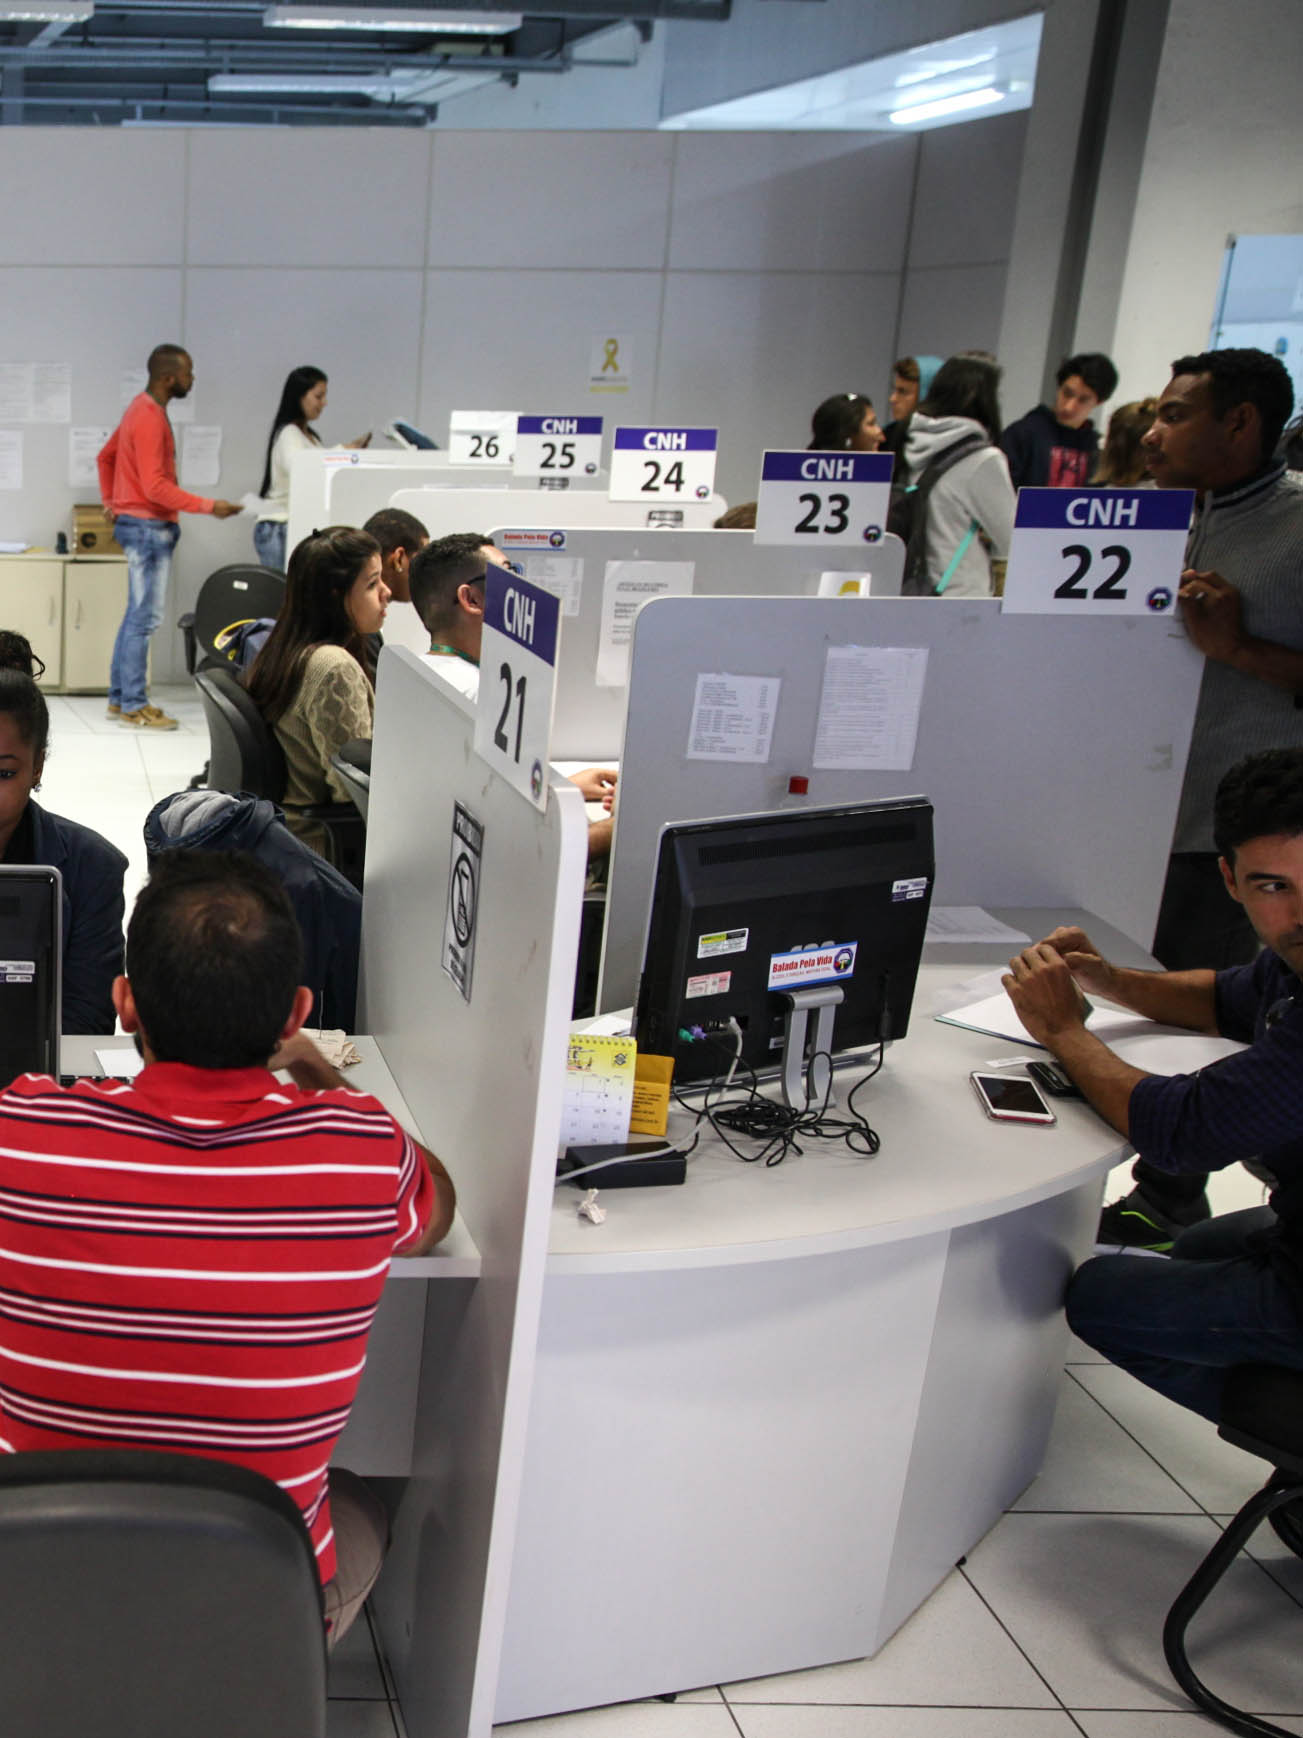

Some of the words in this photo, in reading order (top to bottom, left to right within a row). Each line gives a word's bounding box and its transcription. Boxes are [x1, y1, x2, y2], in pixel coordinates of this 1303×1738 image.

[542, 419, 578, 434] CNH
[469, 435, 500, 458] 26
[644, 432, 687, 450] CNH
[540, 443, 575, 469] 25
[800, 458, 854, 480] CNH
[641, 461, 685, 492] 24
[794, 492, 849, 534] 23
[1065, 498, 1139, 527] CNH
[1053, 545, 1132, 600] 22
[504, 587, 536, 645] CNH
[494, 662, 527, 764] 21
[772, 961, 798, 973] Balada
[800, 958, 815, 968] Pela
[817, 956, 832, 966] Vida
